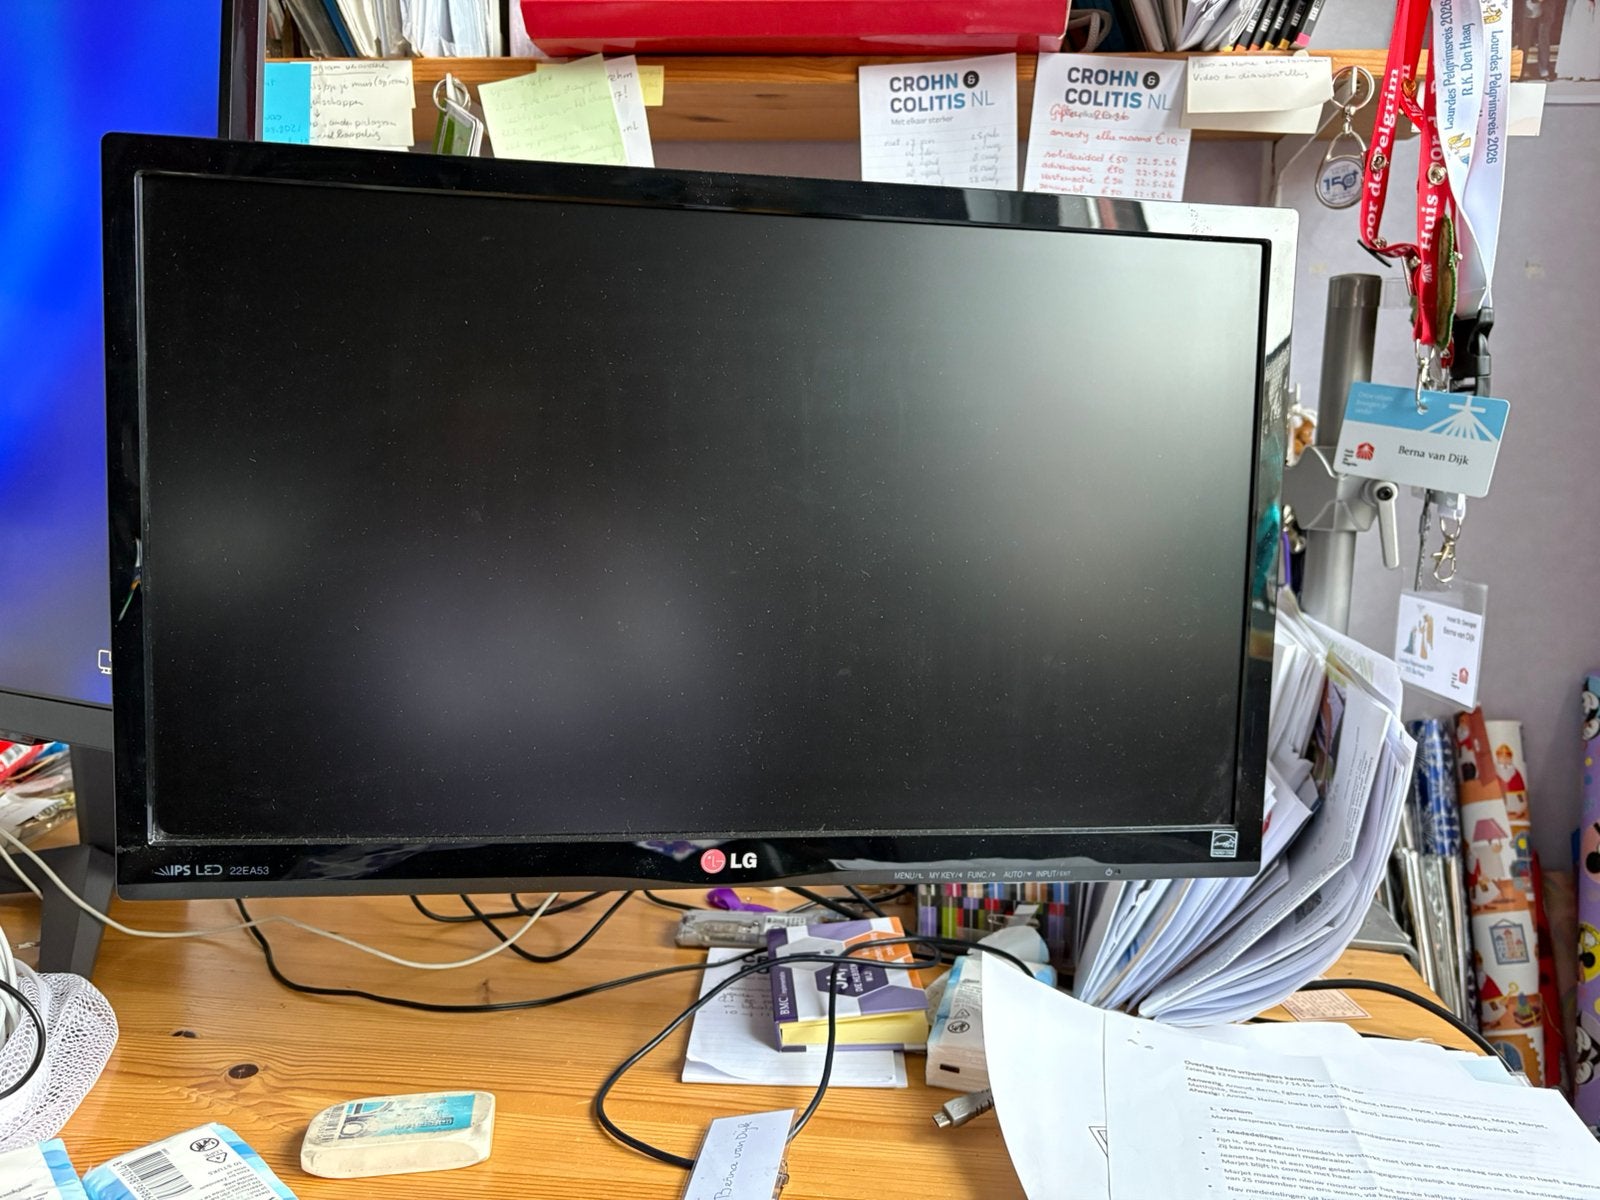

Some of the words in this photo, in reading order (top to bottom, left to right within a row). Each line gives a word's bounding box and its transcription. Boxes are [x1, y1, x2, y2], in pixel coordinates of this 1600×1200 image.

[1459, 22, 1475, 48] Haag
[1442, 26, 1459, 88] Pelgrimsreis
[1460, 49, 1473, 69] Den
[1489, 30, 1503, 71] Lourdes
[890, 73, 958, 92] CROHN
[1067, 67, 1138, 87] CROHN
[1461, 71, 1474, 96] R.K.
[890, 93, 966, 113] COLITIS
[971, 90, 995, 107] NL
[1065, 88, 1143, 109] COLITIS
[1148, 94, 1172, 110] NL
[1484, 72, 1502, 138] Pelgrimsreis
[1443, 89, 1456, 130] Lourdes
[891, 118, 905, 126] Met
[1485, 137, 1499, 165] 2026
[1366, 202, 1379, 240] oor
[1421, 194, 1438, 251] Huis
[1398, 445, 1425, 458] Berna
[1428, 452, 1446, 462] van
[1448, 453, 1470, 465] Dijk
[169, 865, 191, 876] IPS
[196, 864, 223, 876] LED
[230, 866, 270, 876] 22EA53
[730, 852, 758, 868] LG
[929, 871, 941, 879] MY
[779, 995, 791, 1015] BMC
[1226, 1130, 1284, 1140] Mededelingen
[1238, 1117, 1275, 1125] bespreekt
[1295, 1124, 1348, 1134] onderstaande
[1268, 1149, 1300, 1157] februari
[1296, 1147, 1335, 1155] inmiddels
[1328, 1166, 1361, 1174] geleden
[1254, 1179, 1297, 1187] november
[1245, 1187, 1305, 1200] mededelingen
